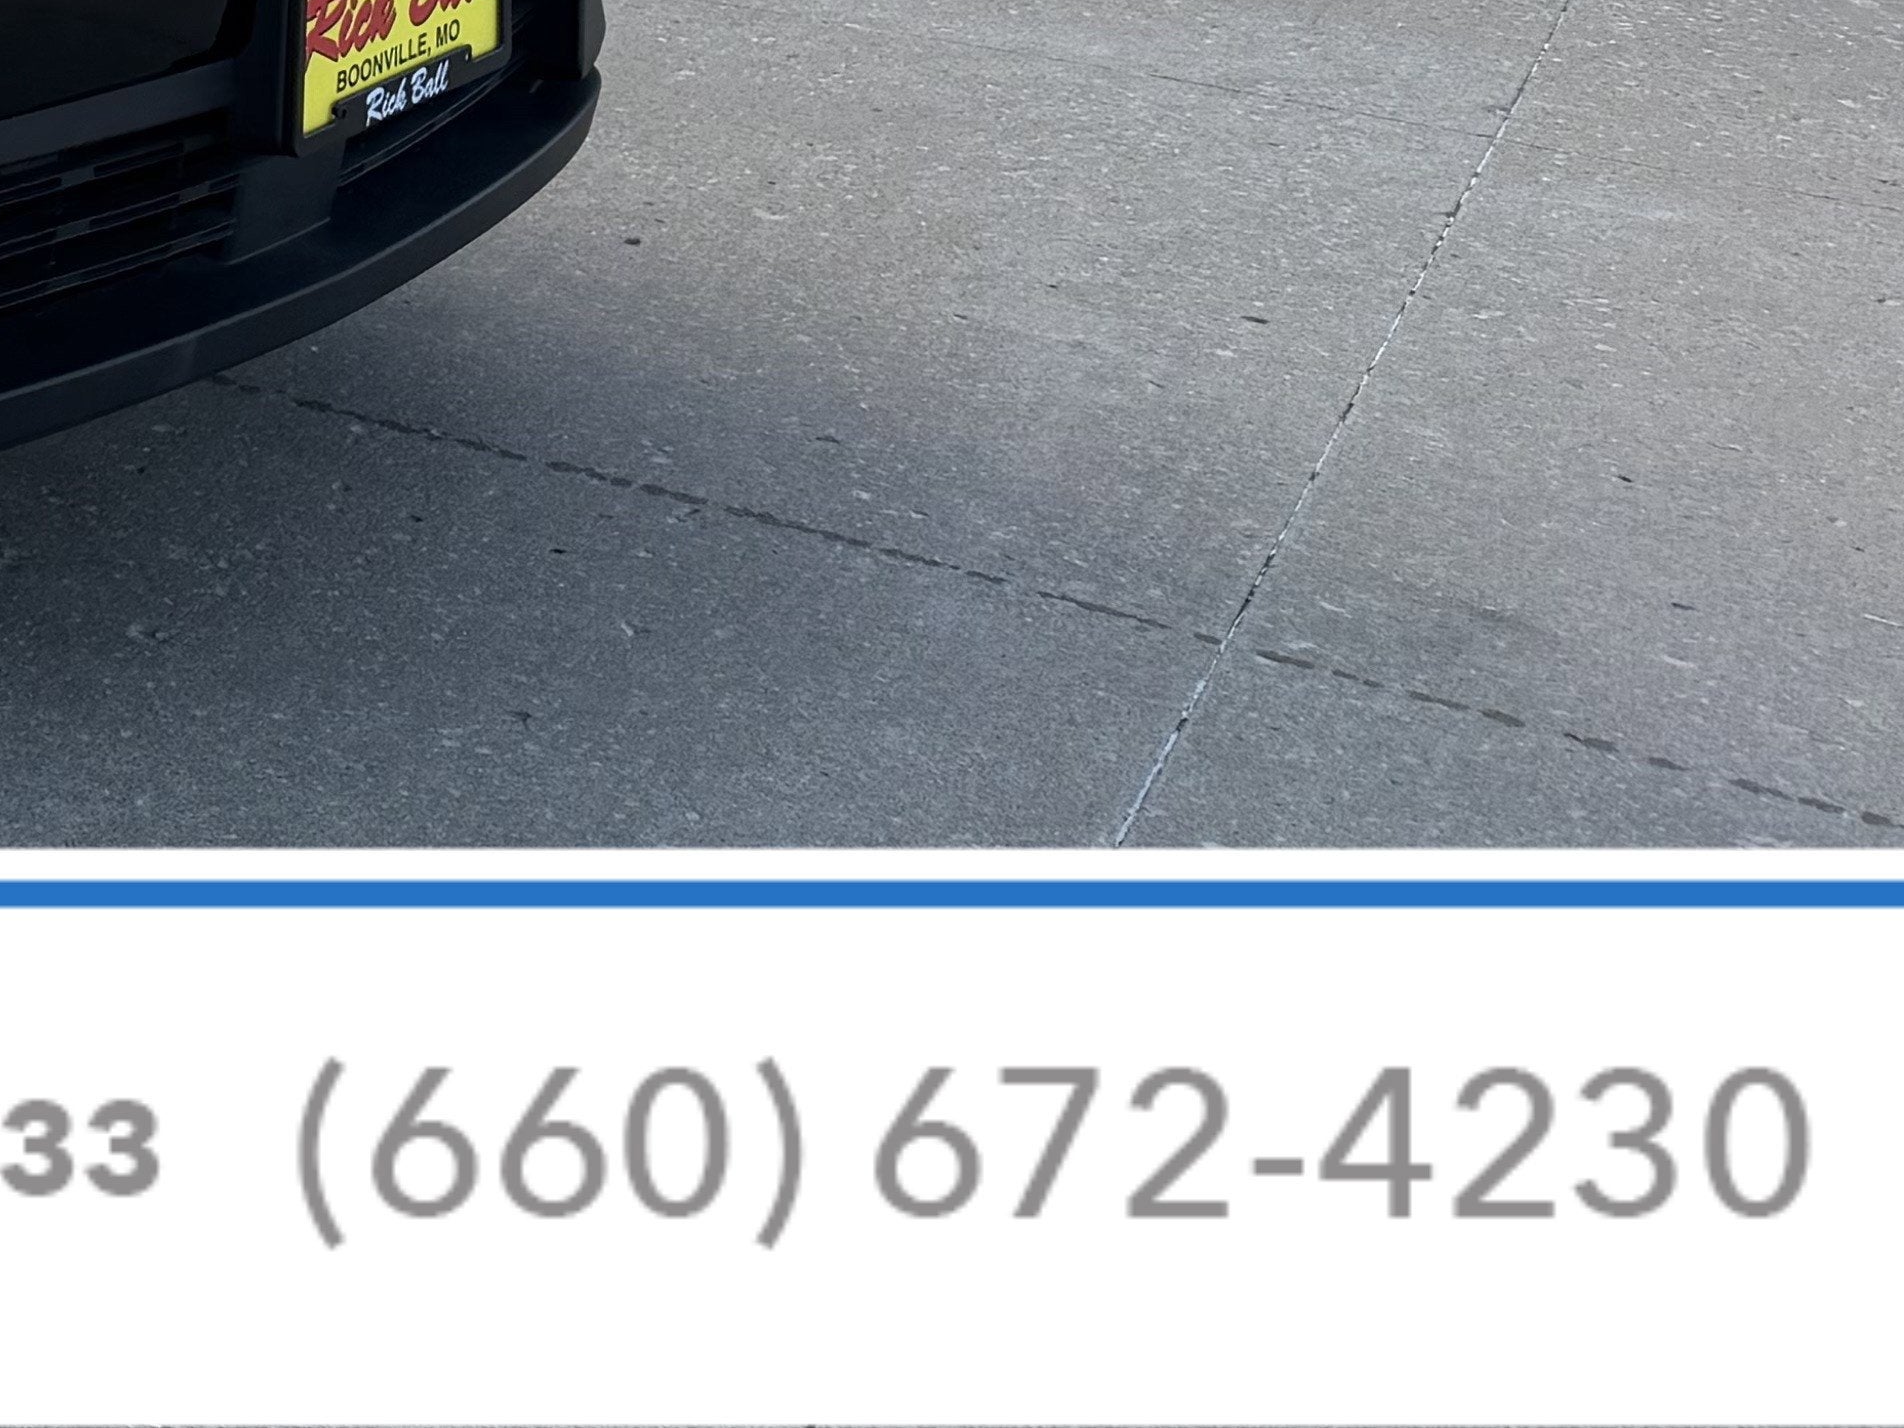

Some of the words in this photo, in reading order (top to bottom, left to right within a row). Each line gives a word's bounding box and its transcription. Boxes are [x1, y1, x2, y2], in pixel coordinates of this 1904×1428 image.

[336, 32, 432, 93] BOONVILLE,
[436, 19, 461, 49] MO
[365, 79, 407, 128] Rick
[411, 60, 449, 104] Ball
